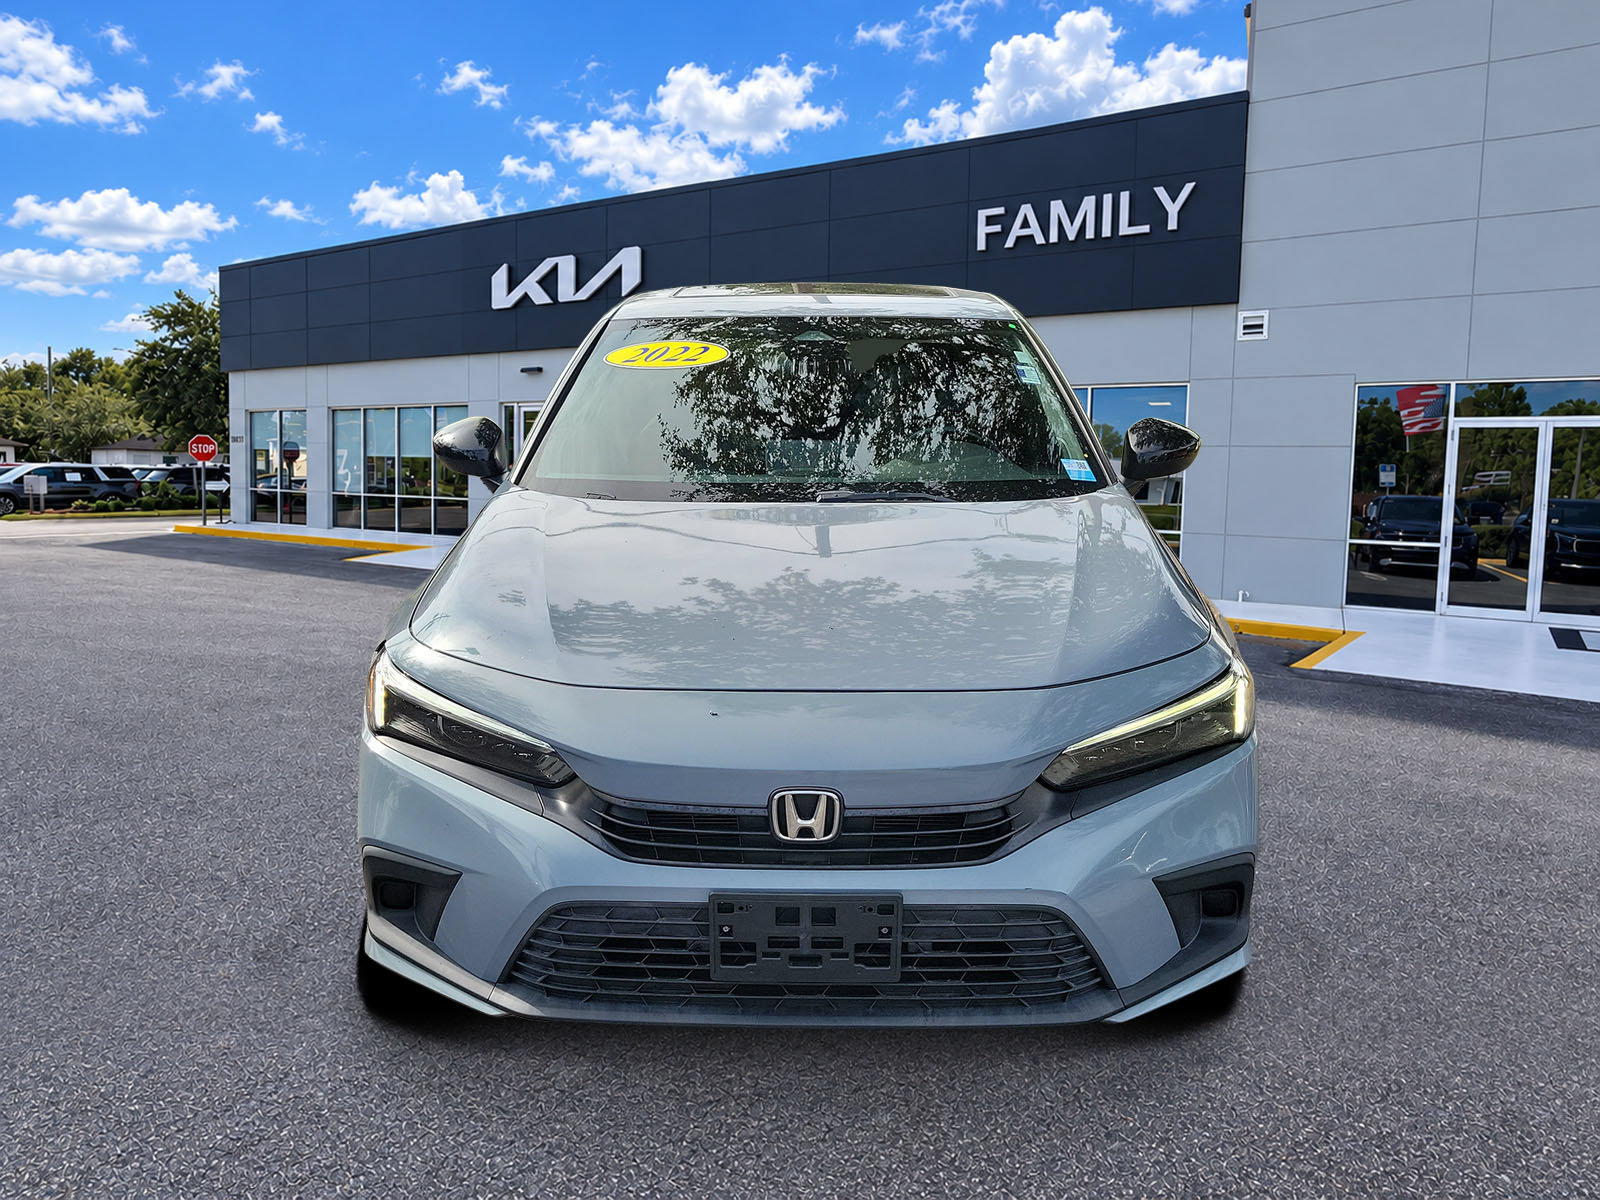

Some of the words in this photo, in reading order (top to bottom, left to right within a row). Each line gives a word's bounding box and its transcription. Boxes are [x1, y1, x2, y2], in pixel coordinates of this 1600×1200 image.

[976, 181, 1197, 252] FAMILY
[491, 245, 642, 310] KIA
[621, 346, 710, 363] 2022
[191, 443, 215, 454] STOP
